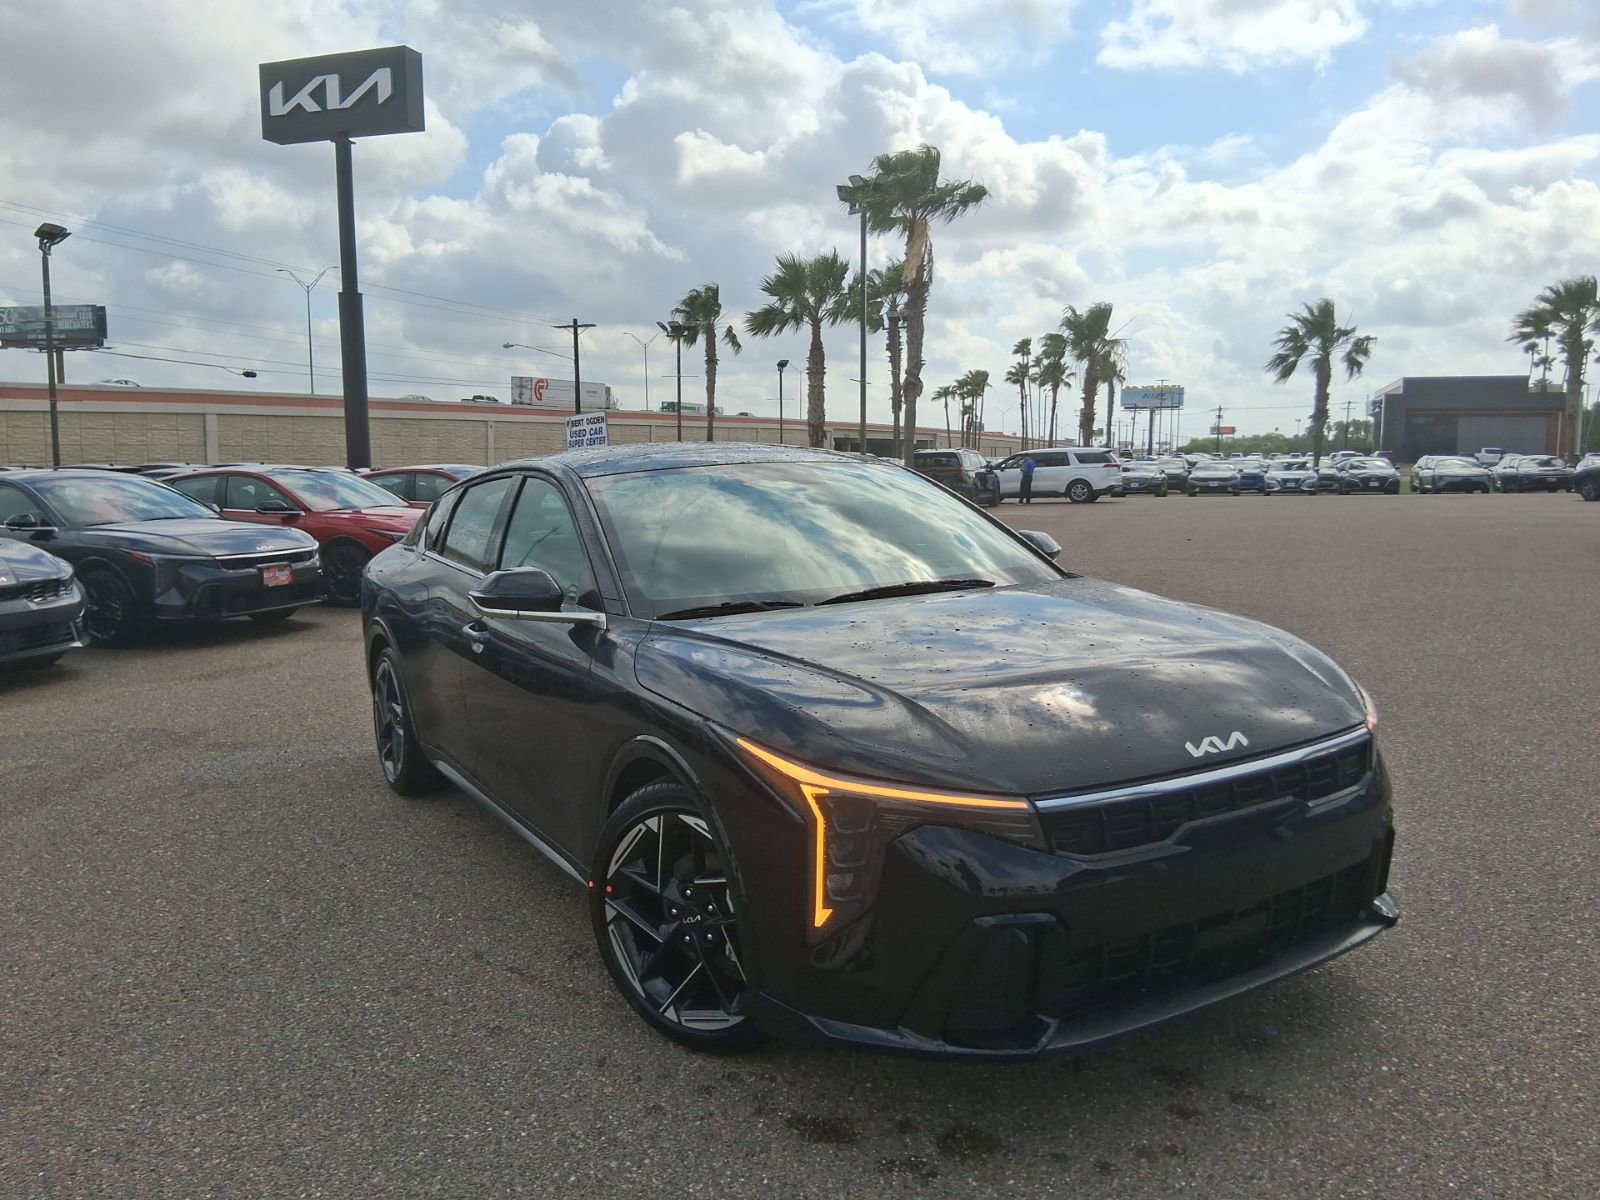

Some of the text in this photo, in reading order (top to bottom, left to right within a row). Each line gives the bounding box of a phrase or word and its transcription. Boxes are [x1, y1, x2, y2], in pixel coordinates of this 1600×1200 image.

[269, 67, 392, 117] KIA
[586, 416, 605, 425] OGDEN
[570, 427, 604, 439] USED CAR
[568, 436, 606, 449] SUPER CENTER
[1184, 731, 1249, 758] KIA
[682, 914, 701, 924] KIA
